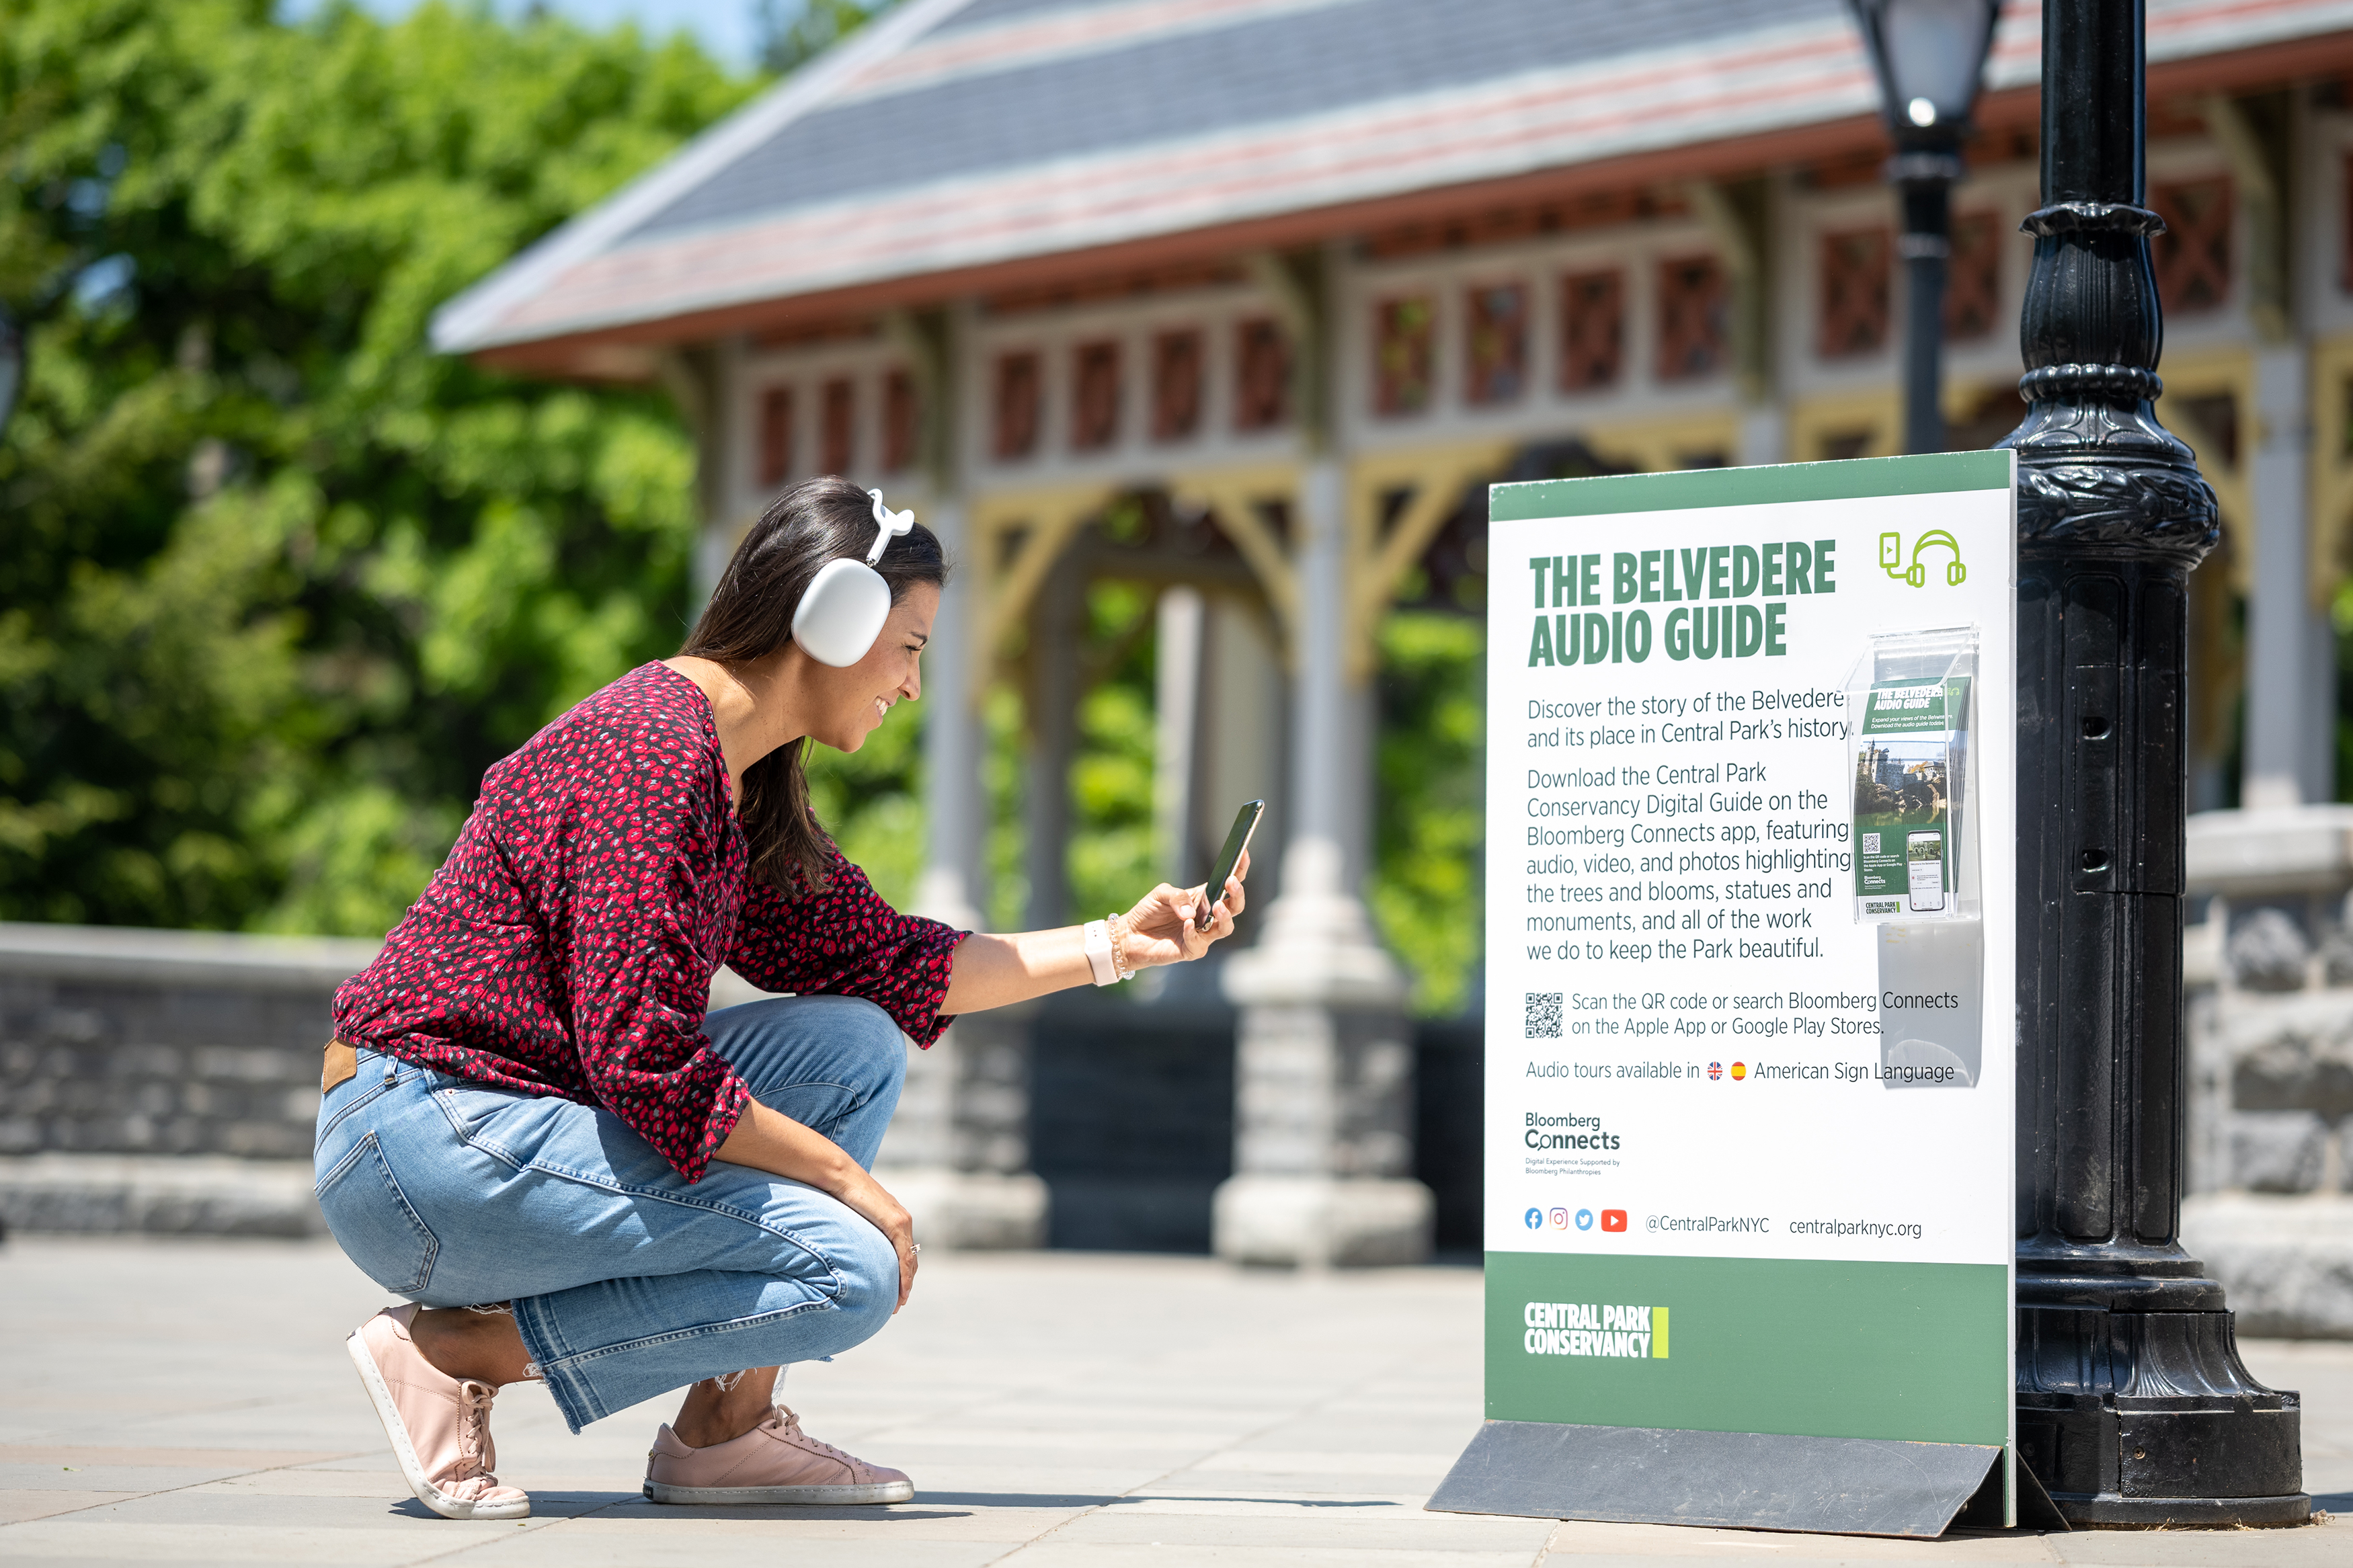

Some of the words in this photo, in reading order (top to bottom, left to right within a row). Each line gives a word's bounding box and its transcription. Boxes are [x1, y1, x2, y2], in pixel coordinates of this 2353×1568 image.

[1529, 553, 1601, 609] THE
[1613, 539, 1836, 605] BELVEDERE
[1527, 609, 1652, 668] AUDIO
[1664, 602, 1787, 661] GUIDE
[1528, 699, 1602, 719] Discover
[1607, 696, 1636, 716] the
[1641, 695, 1687, 718] story
[1693, 692, 1712, 713] of
[1716, 691, 1746, 712] the
[1752, 687, 1844, 710] Belvedere
[1874, 699, 1903, 710] AUDIO
[1903, 698, 1930, 709] GUIDE
[1527, 727, 1559, 748] and
[1566, 727, 1585, 747] its
[1590, 725, 1635, 749] place
[1641, 723, 1655, 743] in
[1661, 720, 1723, 743] Central
[1730, 718, 1782, 741] Park’s
[1788, 717, 1853, 741] history.
[1528, 766, 1616, 789] Download
[1622, 766, 1650, 786] the
[1657, 762, 1719, 785] Central
[1726, 761, 1767, 782] Park
[1527, 797, 1640, 819] Conservancy
[1647, 792, 1703, 817] Digital
[1710, 790, 1763, 813] Guide
[1768, 794, 1792, 811] on
[1798, 789, 1828, 810] the
[1527, 825, 1624, 848] Bloomberg
[1631, 823, 1715, 843] Connects
[1720, 825, 1759, 845] app,
[1766, 819, 1849, 842] featuring
[1527, 854, 1577, 876] audio,
[1583, 853, 1634, 875] video,
[1640, 851, 1673, 872] and
[1679, 851, 1740, 875] photos
[1746, 848, 1851, 874] highlighting
[1526, 883, 1554, 903] the
[1560, 884, 1603, 903] trees
[1609, 880, 1642, 902] and
[1648, 880, 1719, 903] blooms,
[1725, 880, 1791, 900] statues
[1797, 877, 1831, 899] and
[1527, 911, 1636, 934] monuments,
[1642, 909, 1675, 930] and
[1681, 909, 1700, 930] all
[1707, 908, 1726, 930] of
[1730, 908, 1760, 929] the
[1765, 907, 1812, 929] work
[1526, 945, 1552, 960] we
[1557, 940, 1580, 960] do
[1585, 941, 1603, 960] to
[1609, 939, 1652, 963] keep
[1657, 938, 1687, 959] the
[1693, 938, 1733, 959] Park
[1739, 936, 1823, 958] beautiful.
[1572, 993, 1607, 1010] Scan
[1612, 992, 1637, 1009] the
[1641, 992, 1665, 1009] QR
[1670, 992, 1708, 1009] code
[1712, 996, 1728, 1009] or
[1732, 991, 1783, 1009] search
[1789, 991, 1876, 1012] Bloomberg
[1882, 991, 1958, 1009] Connects
[1572, 1022, 1590, 1034] on
[1595, 1017, 1620, 1034] the
[1624, 1017, 1669, 1038] Apple
[1673, 1017, 1706, 1038] App
[1711, 1021, 1728, 1034] or
[1732, 1016, 1788, 1038] Google
[1794, 1016, 1826, 1038] Play
[1831, 1017, 1884, 1034] Stores.
[1525, 1061, 1569, 1078] Audio
[1574, 1062, 1611, 1078] tours
[1616, 1061, 1682, 1079] available
[1687, 1061, 1700, 1079] in
[1754, 1061, 1829, 1079] American
[1834, 1061, 1868, 1083] Sign
[1874, 1060, 1954, 1083] Language
[1525, 1112, 1600, 1132] Bloomberg
[1524, 1128, 1620, 1151] Connects
[1525, 1157, 1544, 1165] Digital
[1546, 1158, 1578, 1166] Experience
[1613, 1159, 1620, 1167] by
[1525, 1167, 1558, 1175] Bloomberg
[1560, 1168, 1601, 1176] Philanthropies
[1646, 1214, 1769, 1233] @CentralParkNYC
[1790, 1219, 1921, 1239] centralparknyc.org
[1524, 1302, 1600, 1329] CENTRAL
[1603, 1305, 1650, 1331] PARK
[1524, 1329, 1650, 1358] CONSERVANCY
